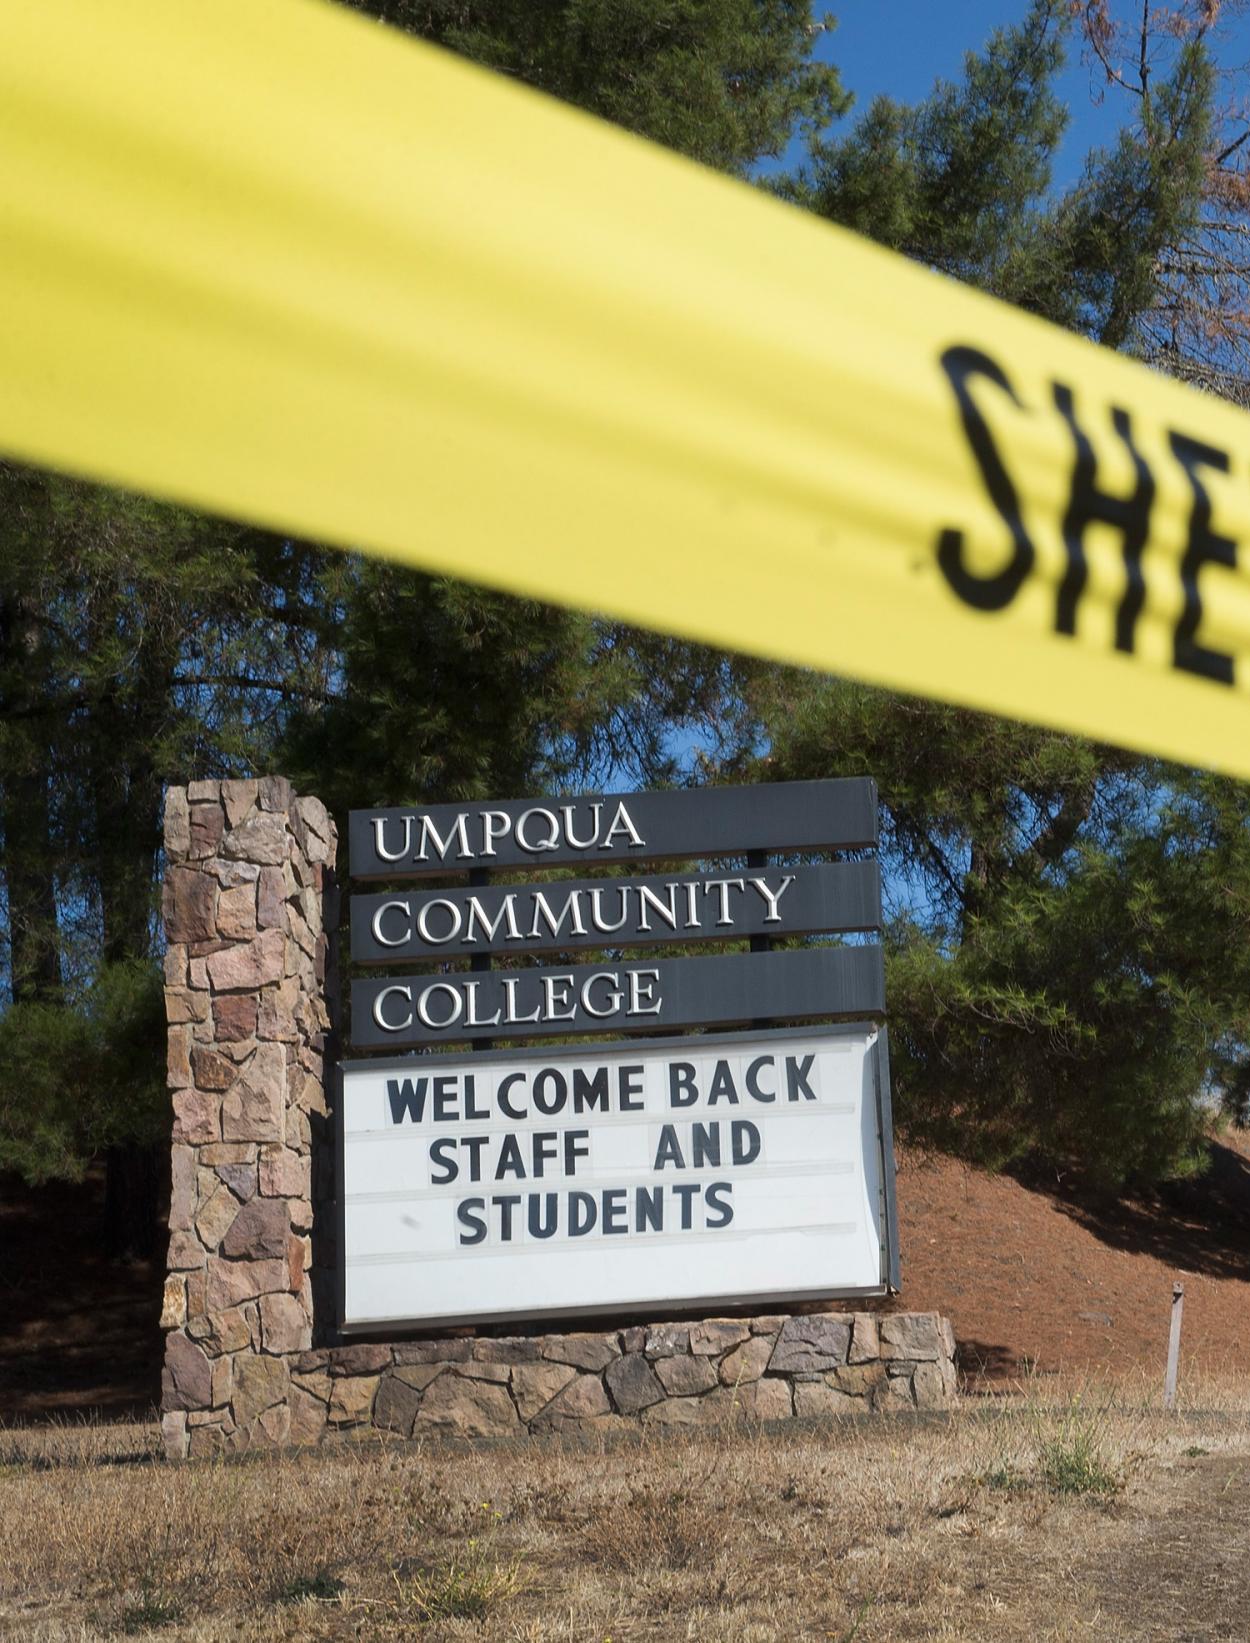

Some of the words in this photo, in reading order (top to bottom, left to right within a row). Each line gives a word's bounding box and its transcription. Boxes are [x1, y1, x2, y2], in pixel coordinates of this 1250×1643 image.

[371, 801, 646, 863] UMPQUA
[371, 875, 796, 948] COMMUNITY
[372, 968, 663, 1032] COLLEGE
[386, 1064, 645, 1125] WELCOME
[668, 1053, 818, 1108] BACK
[429, 1128, 590, 1185] STAFF
[653, 1119, 762, 1171] AND
[457, 1182, 734, 1245] STUDENTS
